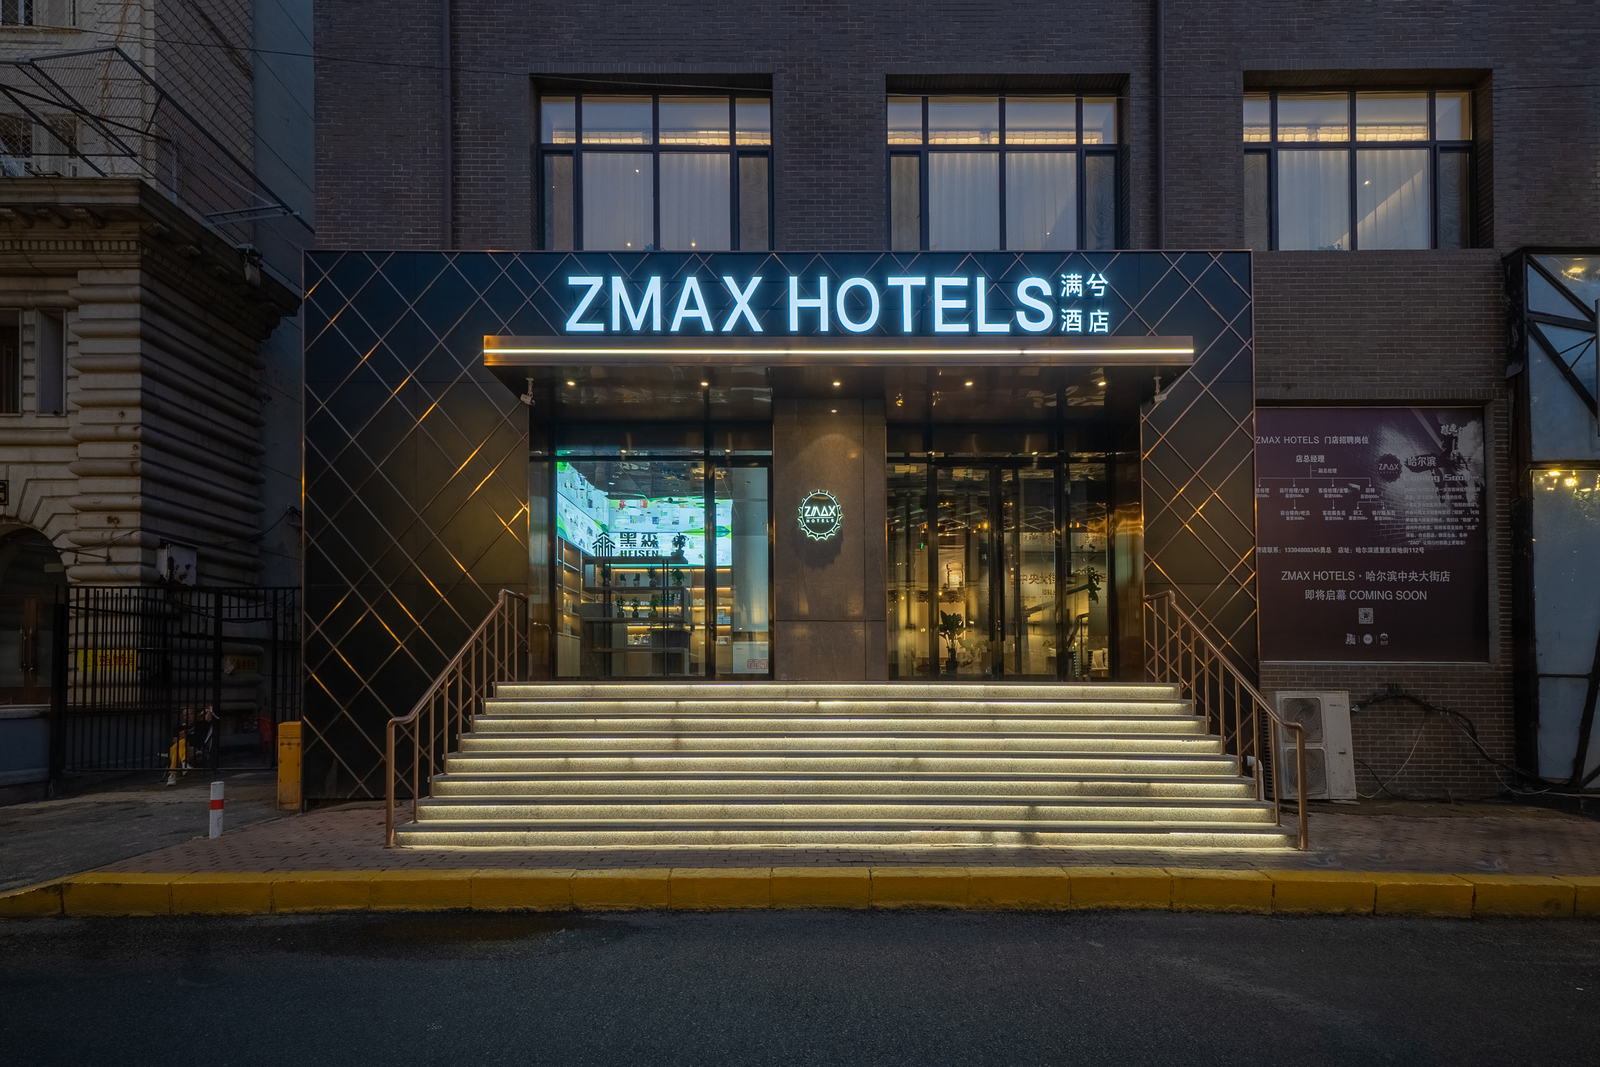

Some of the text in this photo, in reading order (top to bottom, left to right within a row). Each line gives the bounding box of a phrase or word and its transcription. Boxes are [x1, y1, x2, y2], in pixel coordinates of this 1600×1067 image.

[1060, 273, 1109, 298] 满兮
[565, 275, 1054, 333] ZMAX HOTELS
[1060, 308, 1110, 334] 酒店
[1256, 436, 1369, 445] ZMAX HOTELS 门店招聘岗位
[1296, 455, 1325, 463] 店总经理
[1407, 456, 1437, 467] 哈尔滨
[804, 505, 837, 517] ZMAX
[1281, 570, 1451, 582] ZMAX HOTELS 哈尔滨中央大街店
[1305, 589, 1427, 601] 即将启幕 COMING SOON
